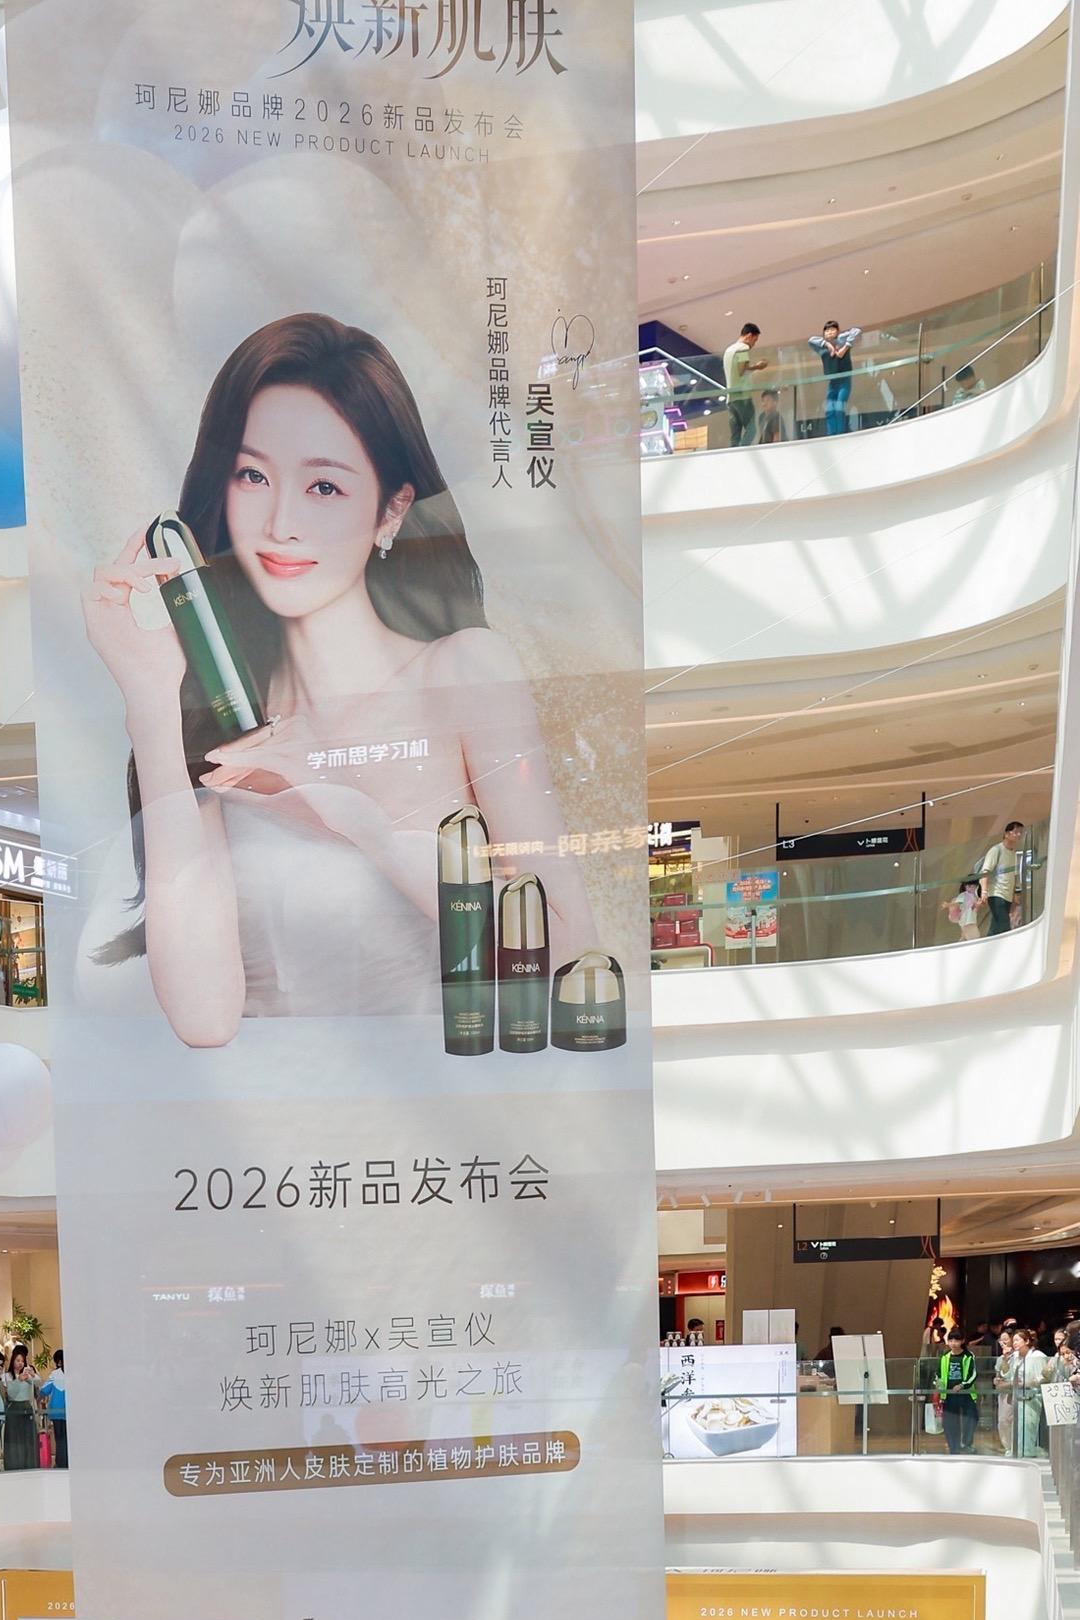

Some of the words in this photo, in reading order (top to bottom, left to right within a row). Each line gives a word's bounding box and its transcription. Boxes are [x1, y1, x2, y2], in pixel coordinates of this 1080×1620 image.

[266, 0, 568, 79] 焕新肌肤
[134, 82, 526, 141] 珂尼娜品牌2026新品发布会
[174, 125, 226, 143] 2026
[237, 129, 282, 149] NEW
[294, 132, 396, 155] PRODUCT
[407, 141, 491, 163] LAUNCH
[486, 276, 513, 490] 珂尼娜品牌代言人
[526, 384, 557, 490] 吴宣仪
[307, 738, 430, 769] 学而思学习机
[451, 900, 482, 912] KÉNINA
[512, 961, 540, 973] KÉNINA
[576, 1014, 604, 1024] KÉNINA
[174, 1153, 551, 1211] 2026新品发布会
[245, 1311, 496, 1358] 珂尼娜x吴宣仪
[219, 1361, 523, 1414] 焕新肌肤高光之旅
[179, 1440, 567, 1487] 专为亚洲人皮肤定制的植物护肤品牌
[701, 1608, 734, 1617] 2026
[741, 1608, 772, 1617] NEW
[779, 1608, 850, 1618] PRODUCT
[857, 1609, 919, 1619] LAUNCH
